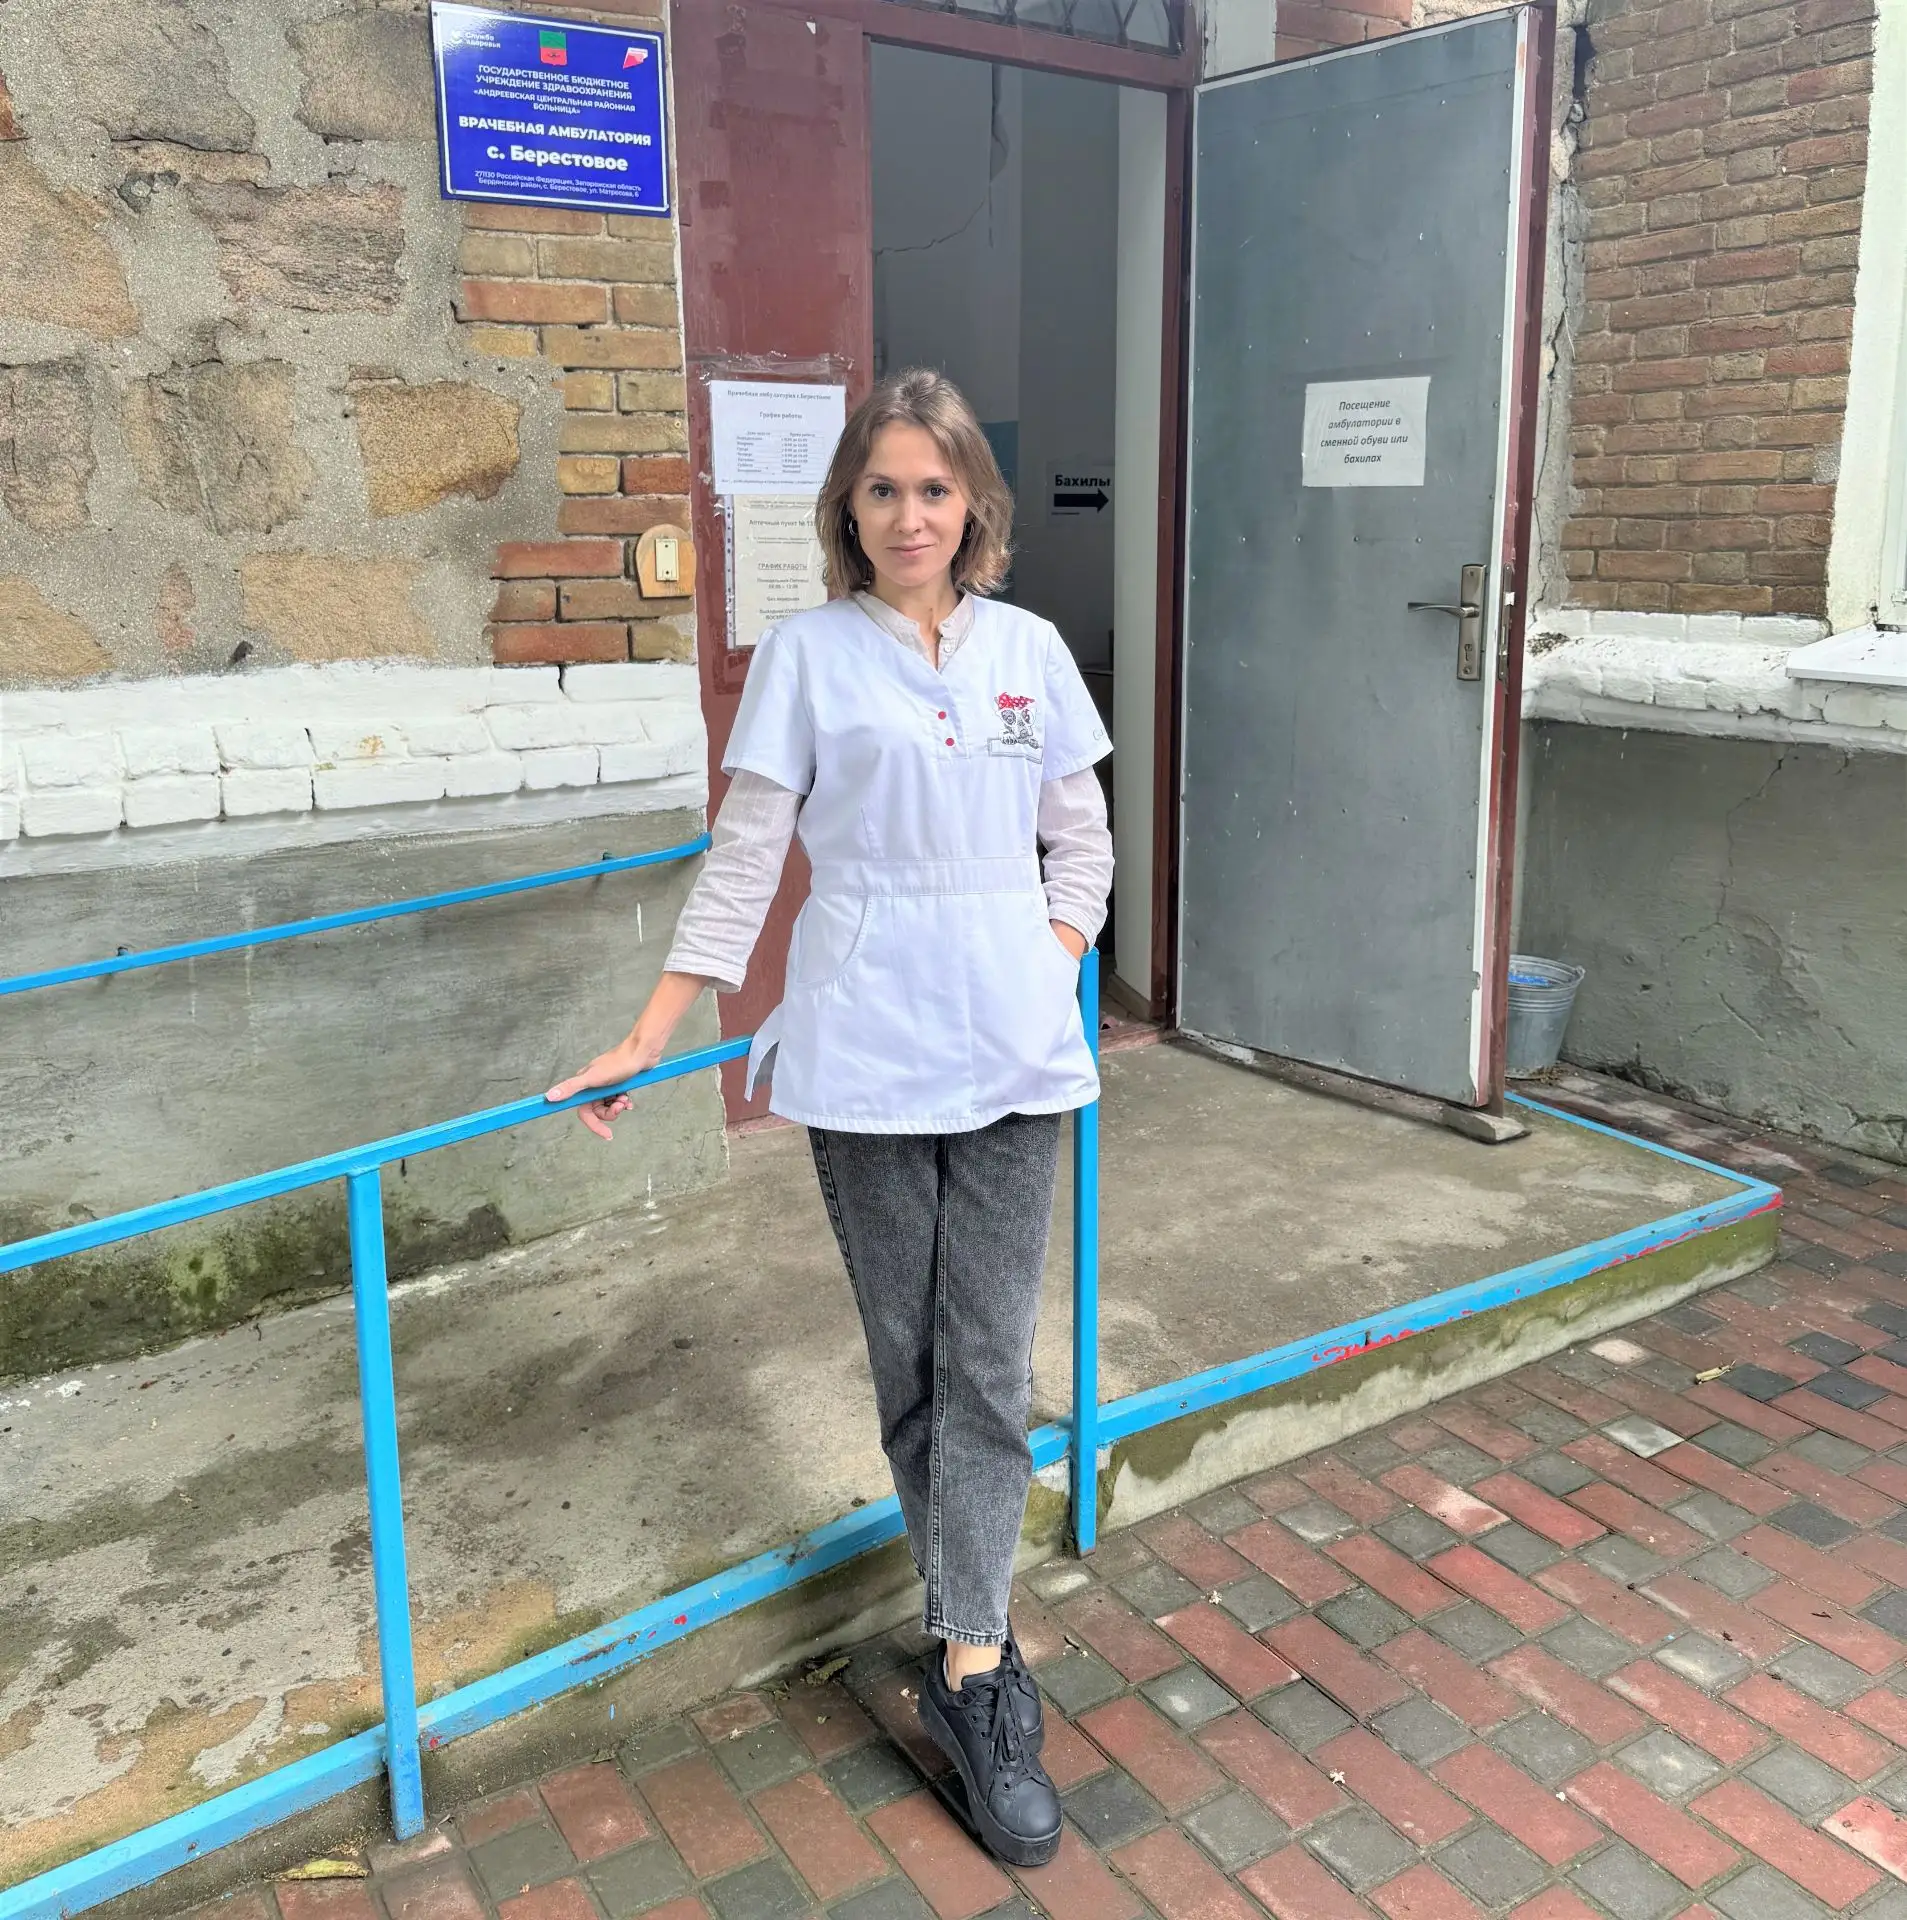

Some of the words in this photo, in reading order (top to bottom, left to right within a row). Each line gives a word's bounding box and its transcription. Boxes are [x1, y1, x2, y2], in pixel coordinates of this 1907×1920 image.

[479, 64, 569, 83] ГОСУДАРСТВЕННОЕ
[571, 75, 629, 90] БЮДЖЕТНОЕ
[476, 74, 540, 90] УЧРЕЖДЕНИЕ
[542, 82, 632, 100] ЗДРАВООХРАНЕНИЯ
[474, 88, 535, 101] «АНДРЕЕВСКАЯ
[537, 95, 593, 108] ЦЕНТРАЛЬНАЯ
[594, 100, 635, 112] РАЙОННАЯ
[533, 102, 580, 115] БОЛЬНИЦА»
[459, 115, 545, 136] ВРАЧЕБНАЯ
[548, 124, 651, 146] АМБУЛАТОРИЯ
[487, 145, 505, 160] с.
[510, 144, 629, 171] Берестовое
[478, 177, 520, 188] Бердянский
[496, 172, 535, 182] Российская
[617, 182, 642, 192] область
[1339, 400, 1391, 411] Посещение
[759, 411, 781, 419] График
[781, 412, 802, 420] работы
[1328, 417, 1394, 431] амбулатории
[1395, 417, 1401, 425] в
[1320, 436, 1359, 447] сменной
[1360, 434, 1389, 446] обуви
[1390, 435, 1408, 444] или
[1343, 453, 1382, 464] бахилах
[1055, 474, 1111, 487] Бахилы
